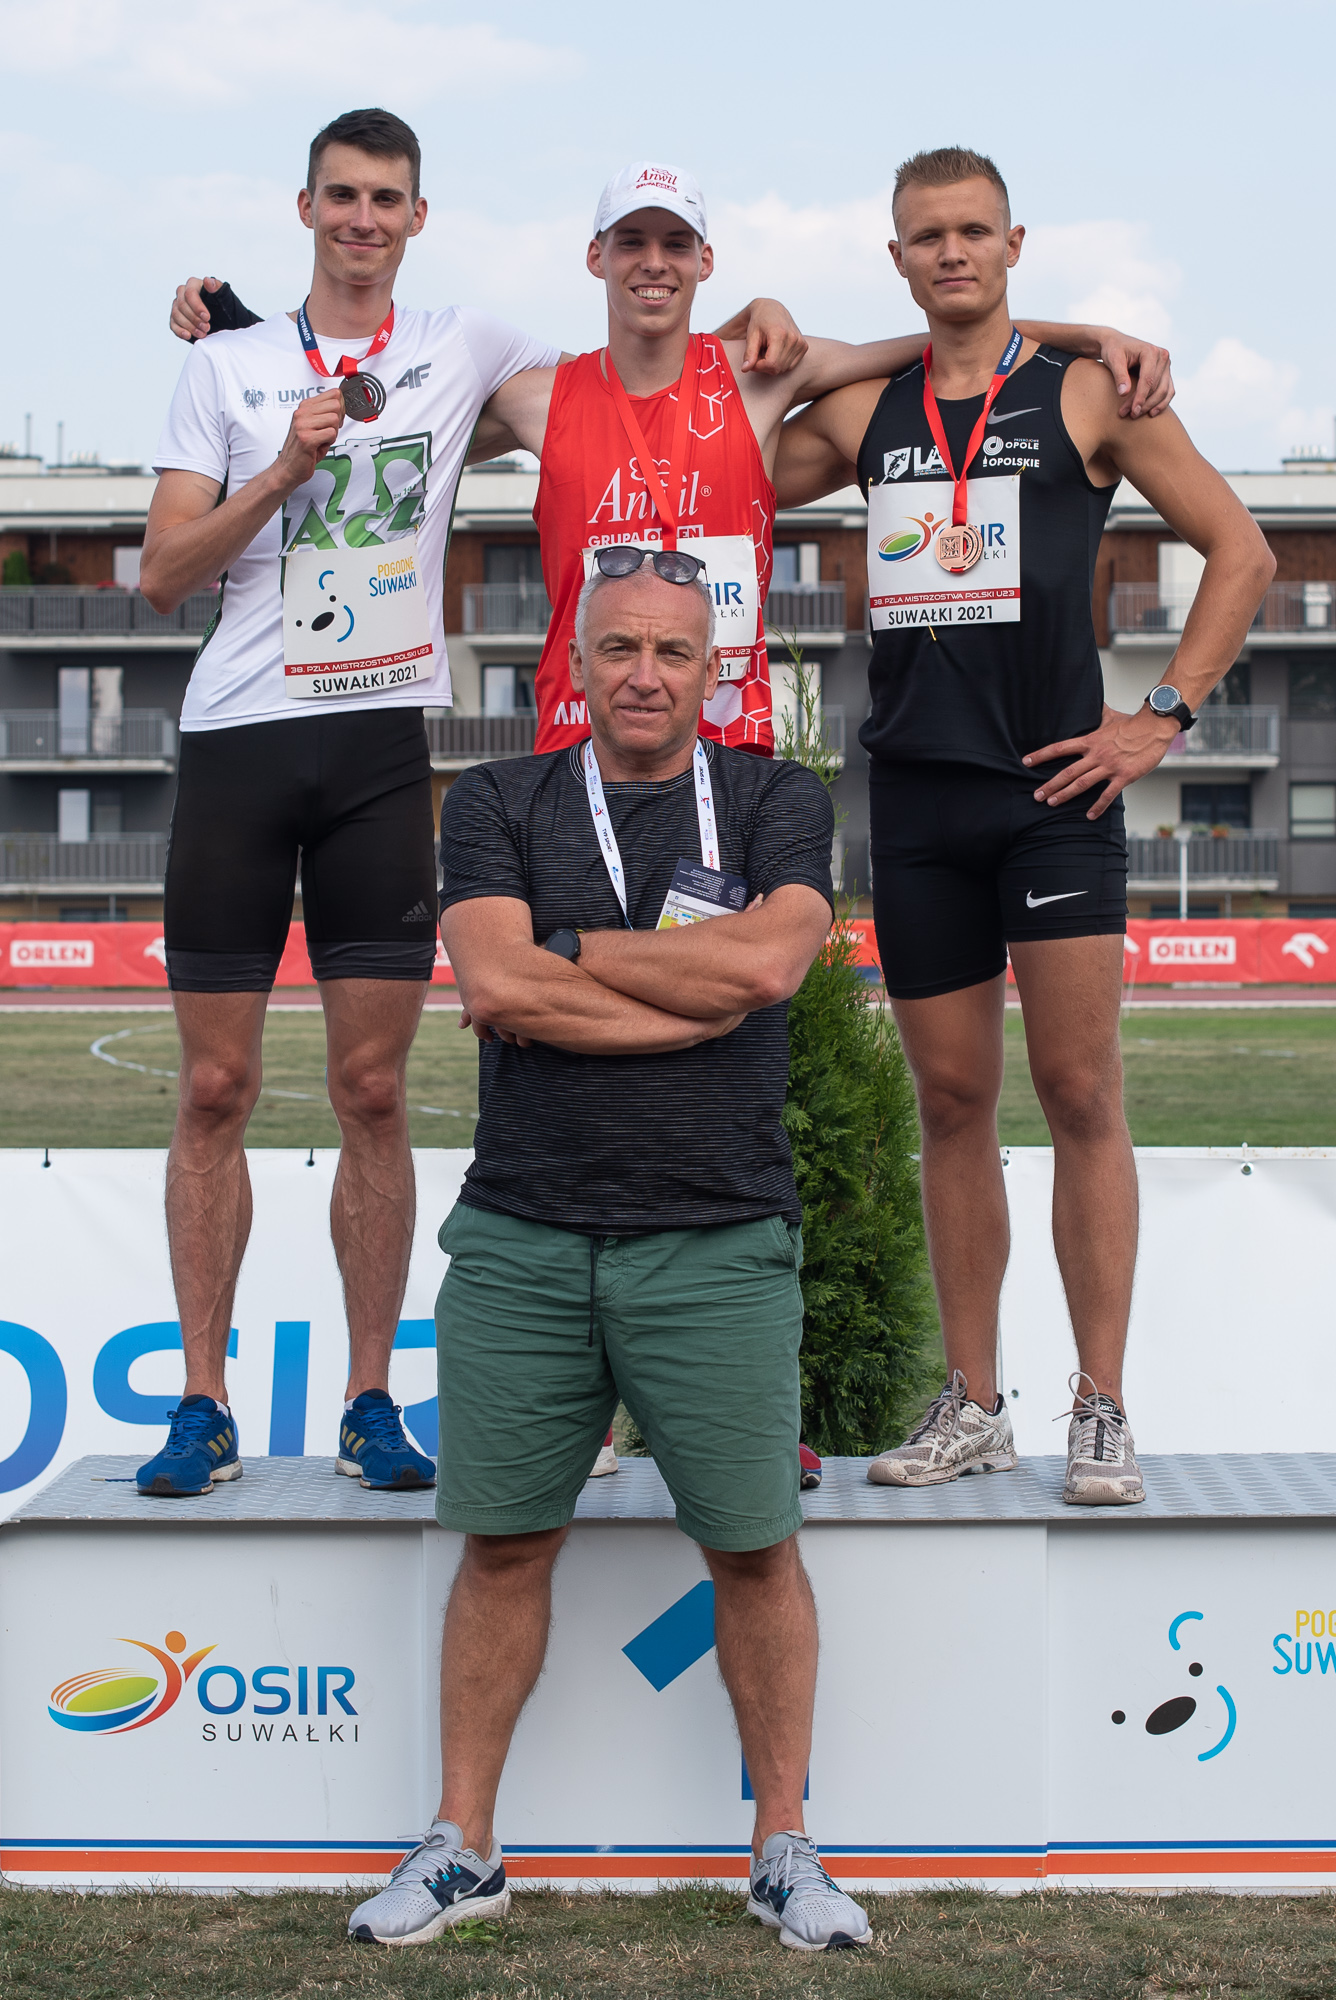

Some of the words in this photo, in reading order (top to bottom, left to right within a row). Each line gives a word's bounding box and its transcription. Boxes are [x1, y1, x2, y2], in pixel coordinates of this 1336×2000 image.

[636, 169, 678, 186] Anwil
[1005, 441, 1040, 450] OPOLE
[989, 457, 1040, 468] OPOLSKIE
[587, 467, 700, 524] Anil
[588, 532, 641, 547] GRUPA
[377, 556, 415, 578] POGODNE
[884, 597, 903, 605] PZLA
[904, 592, 963, 603] MISTRZOSTWA
[965, 591, 995, 600] POLSKI
[996, 589, 1015, 598] U23
[888, 607, 952, 626] SUWAŁKI
[957, 605, 993, 621] 2021
[290, 666, 305, 674] 38.
[306, 664, 331, 673] PZLA
[332, 656, 393, 671] MISTRZOSTWA
[394, 650, 417, 662] POLSKI
[417, 646, 430, 656] U23
[312, 671, 385, 693] SUWAŁKI
[388, 664, 418, 684] 2021
[553, 700, 591, 725] AN
[402, 914, 432, 922] adidas
[17, 947, 87, 962] ORLEN
[1157, 943, 1228, 959] ORLEN
[197, 1665, 359, 1716] OSIR
[202, 1723, 359, 1743] SUWAŁKI
